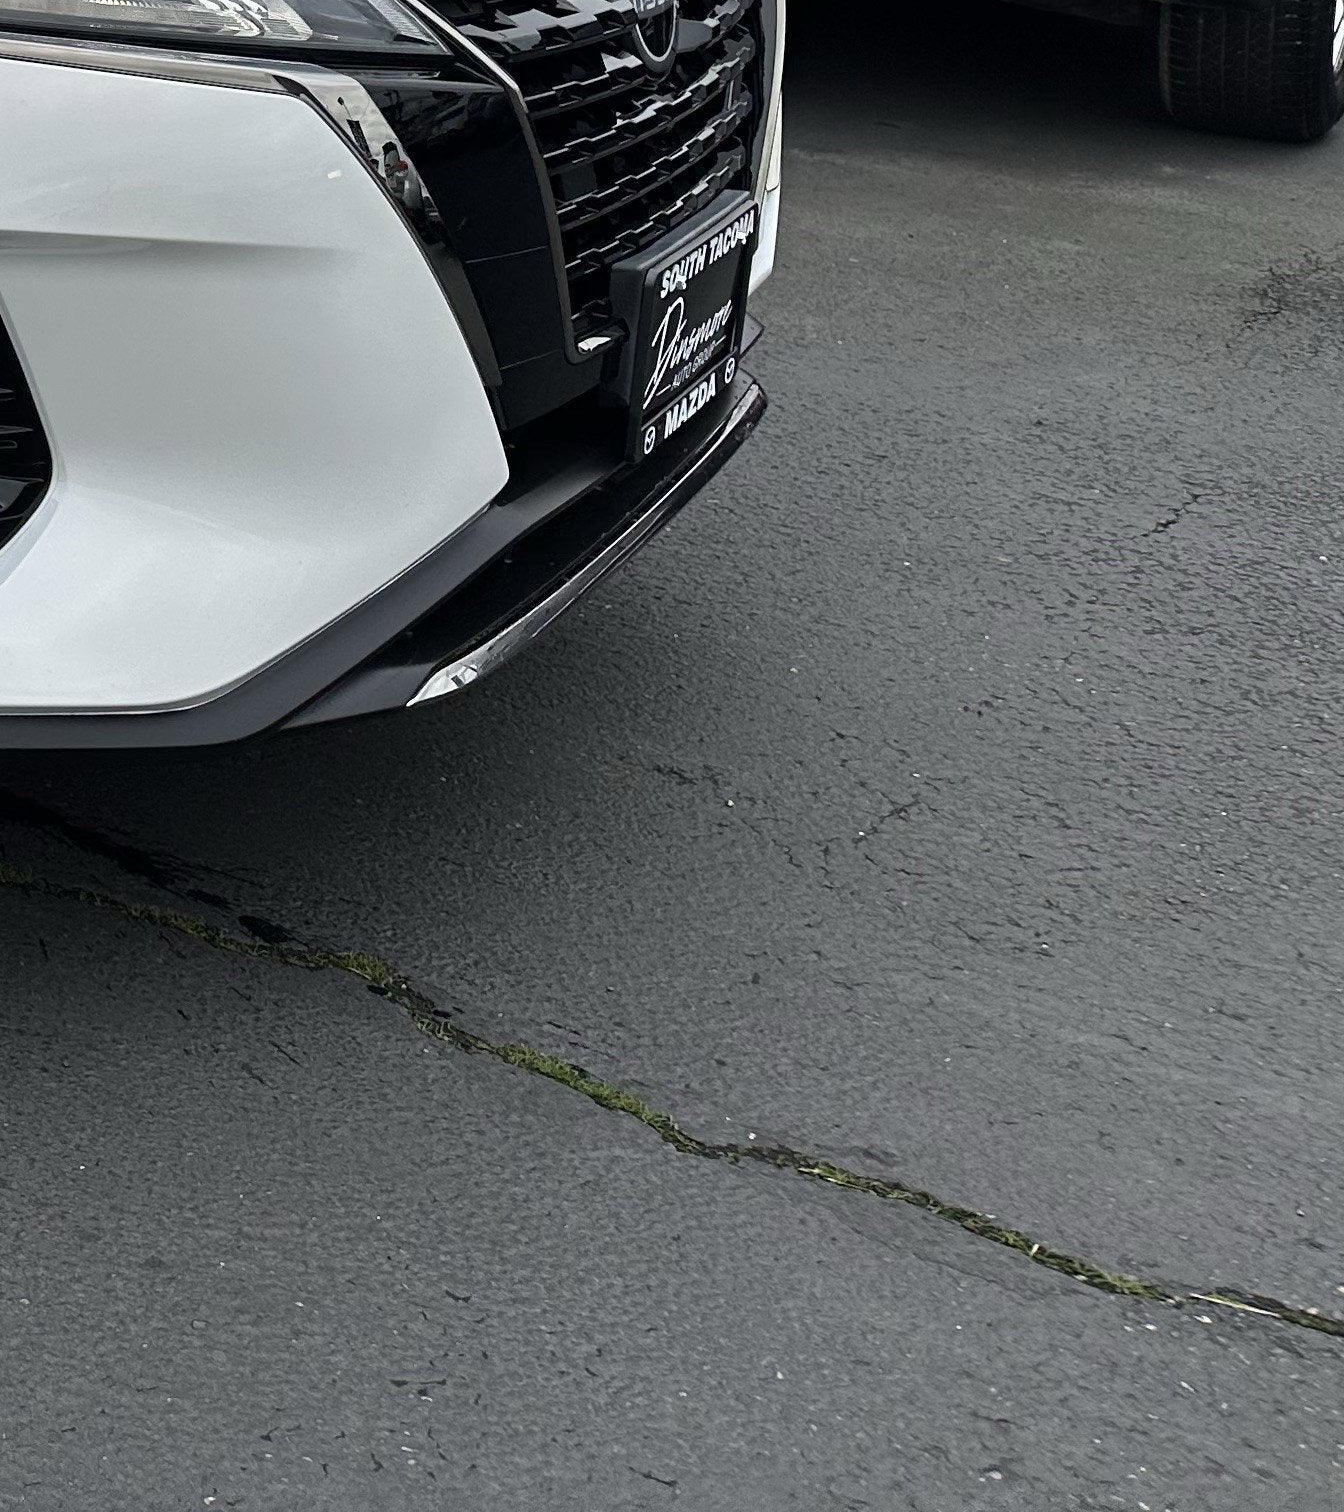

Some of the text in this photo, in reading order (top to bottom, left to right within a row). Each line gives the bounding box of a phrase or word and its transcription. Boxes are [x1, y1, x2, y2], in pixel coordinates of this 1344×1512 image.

[660, 209, 755, 299] SOUTH TACOMA
[642, 296, 733, 410] Dinsmore
[663, 372, 717, 439] MAZDA
